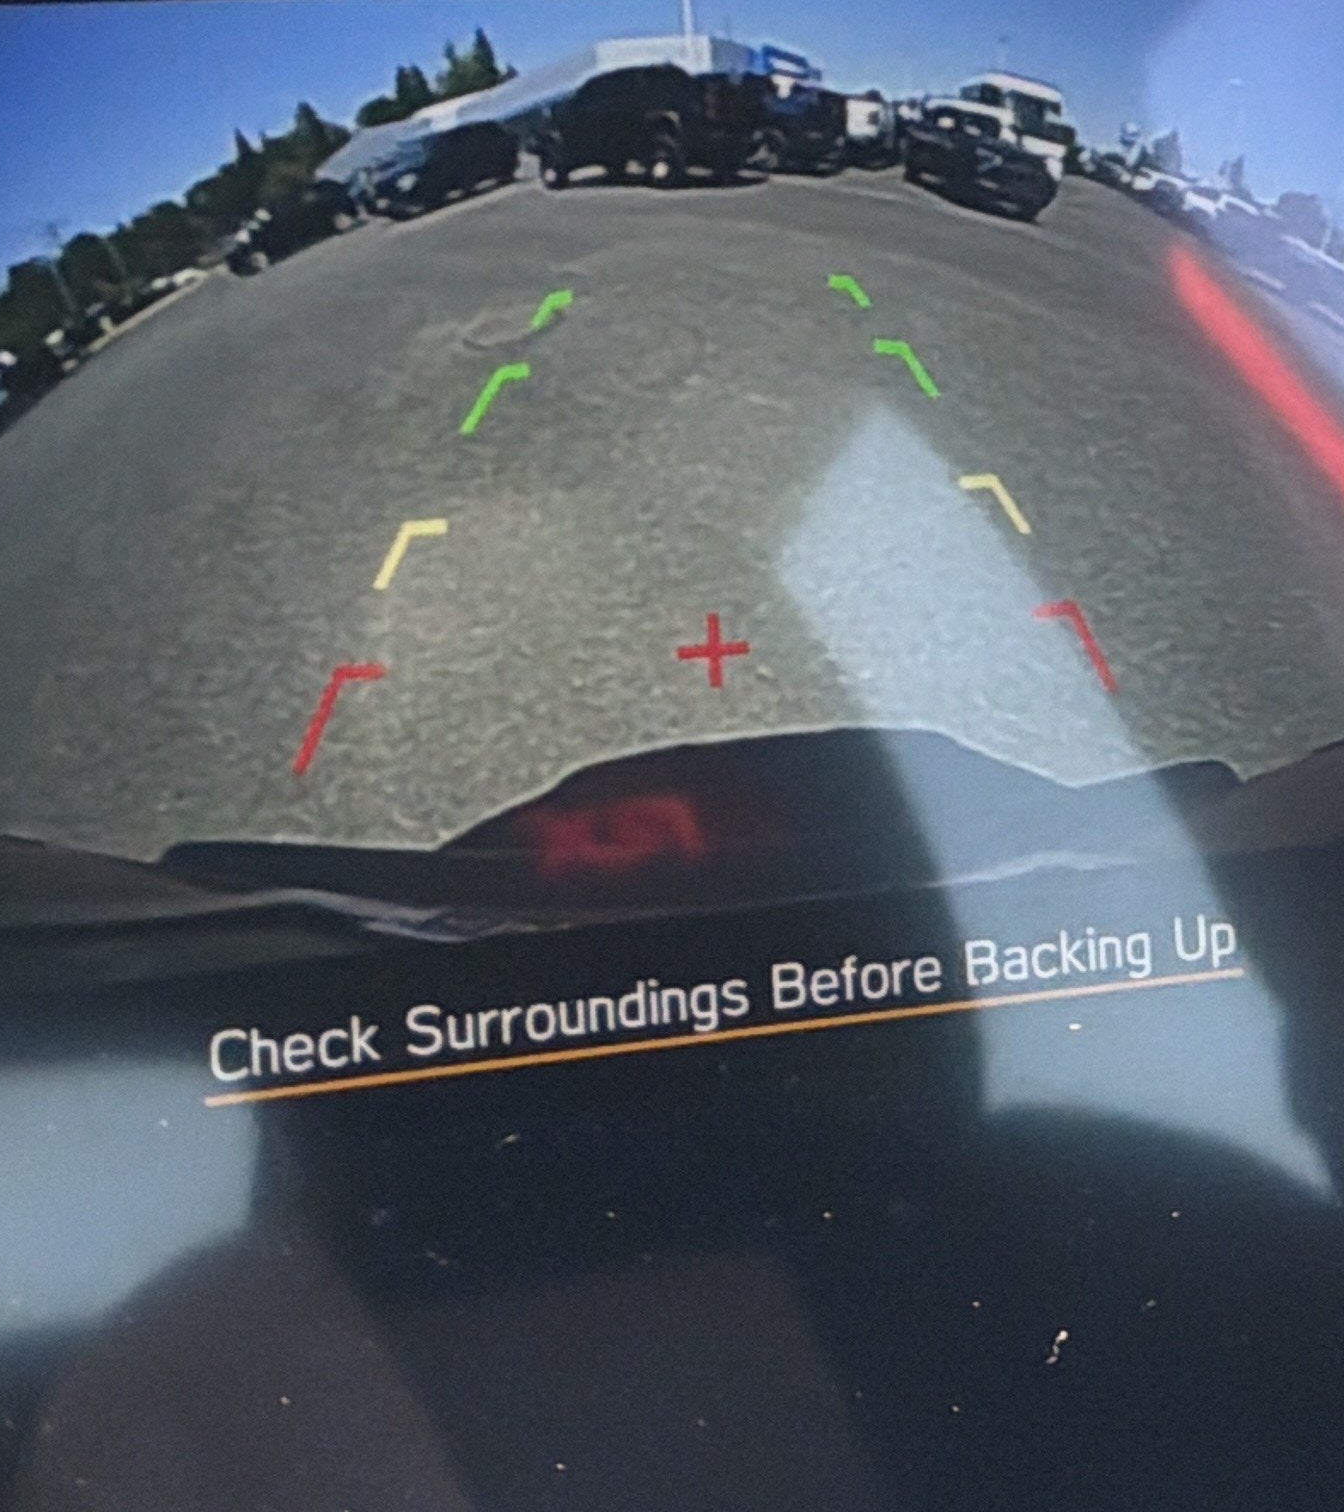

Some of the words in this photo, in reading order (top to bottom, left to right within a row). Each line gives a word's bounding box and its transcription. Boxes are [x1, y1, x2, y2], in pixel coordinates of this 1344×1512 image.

[209, 1014, 380, 1084] Check
[405, 975, 750, 1058] Surroundings
[771, 951, 944, 1012] Before
[963, 925, 1153, 986] Backing
[1172, 915, 1237, 970] Up
